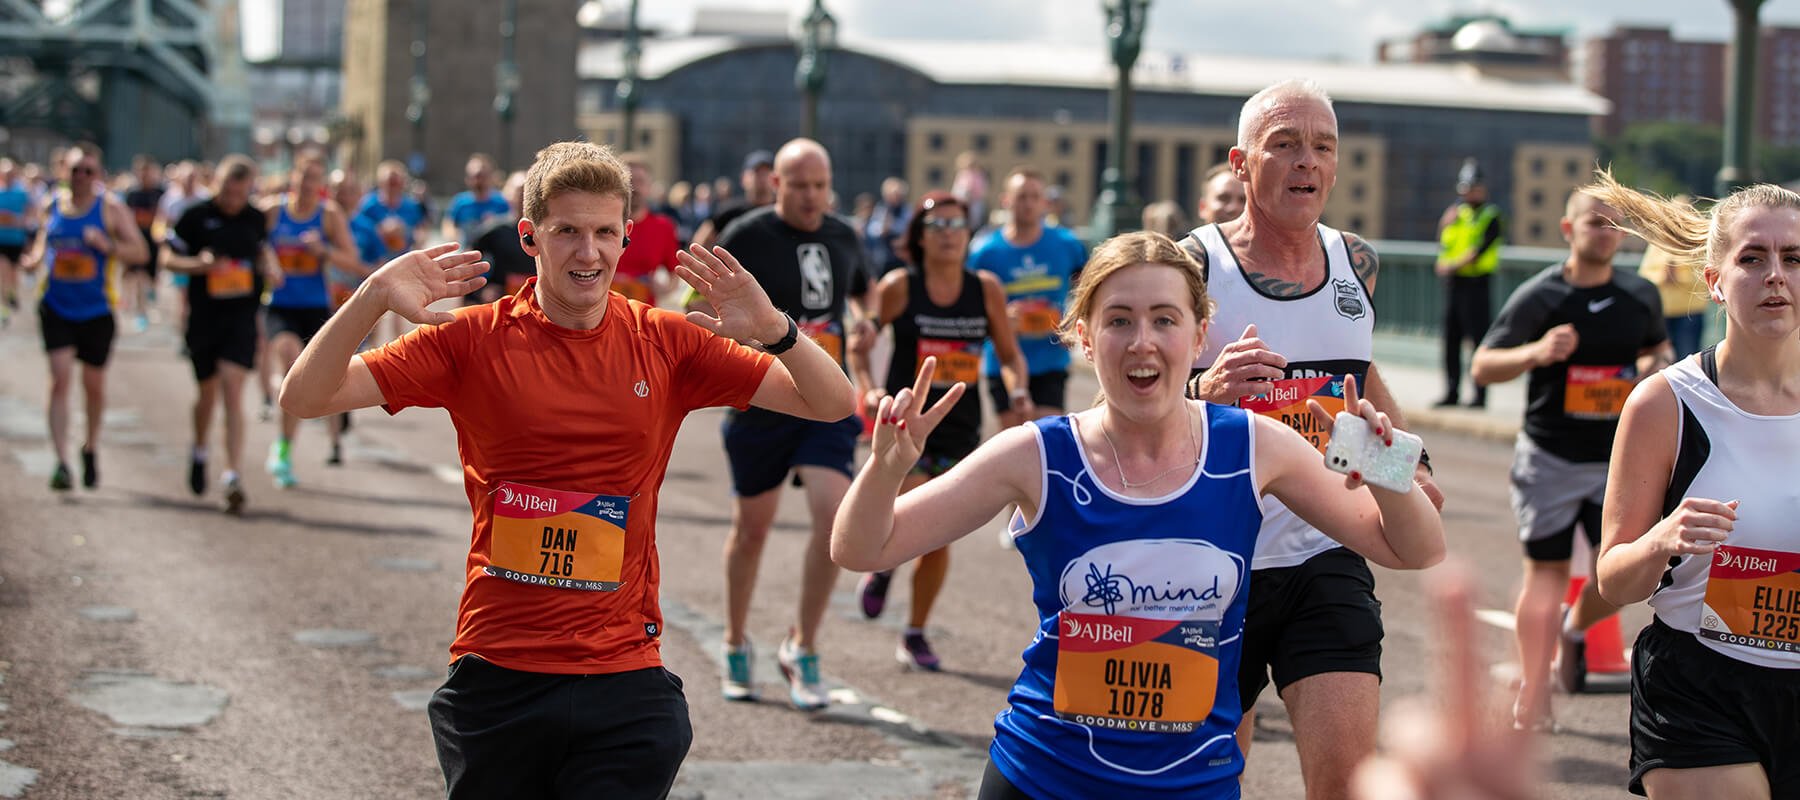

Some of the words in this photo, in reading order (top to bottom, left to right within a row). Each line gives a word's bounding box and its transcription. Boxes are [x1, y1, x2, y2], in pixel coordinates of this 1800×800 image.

[512, 492, 557, 513] AJBell
[541, 526, 578, 552] DAN
[539, 551, 574, 577] 716
[1730, 555, 1777, 573] AJBell
[505, 571, 572, 588] GOODMOVE
[585, 582, 603, 591] M&S
[1124, 575, 1222, 605] mind
[1144, 604, 1167, 612] better
[1168, 604, 1195, 612] mental
[1196, 602, 1217, 612] health
[1753, 585, 1800, 615] ELLIE
[1080, 622, 1132, 643] AJBell
[1749, 611, 1800, 641] 1225
[1719, 633, 1792, 651] GOODMOVE
[1105, 658, 1172, 689] OLIVIA
[1108, 689, 1164, 718] 1078
[1076, 715, 1156, 731] GOODMOVE
[1172, 722, 1193, 732] M&S
